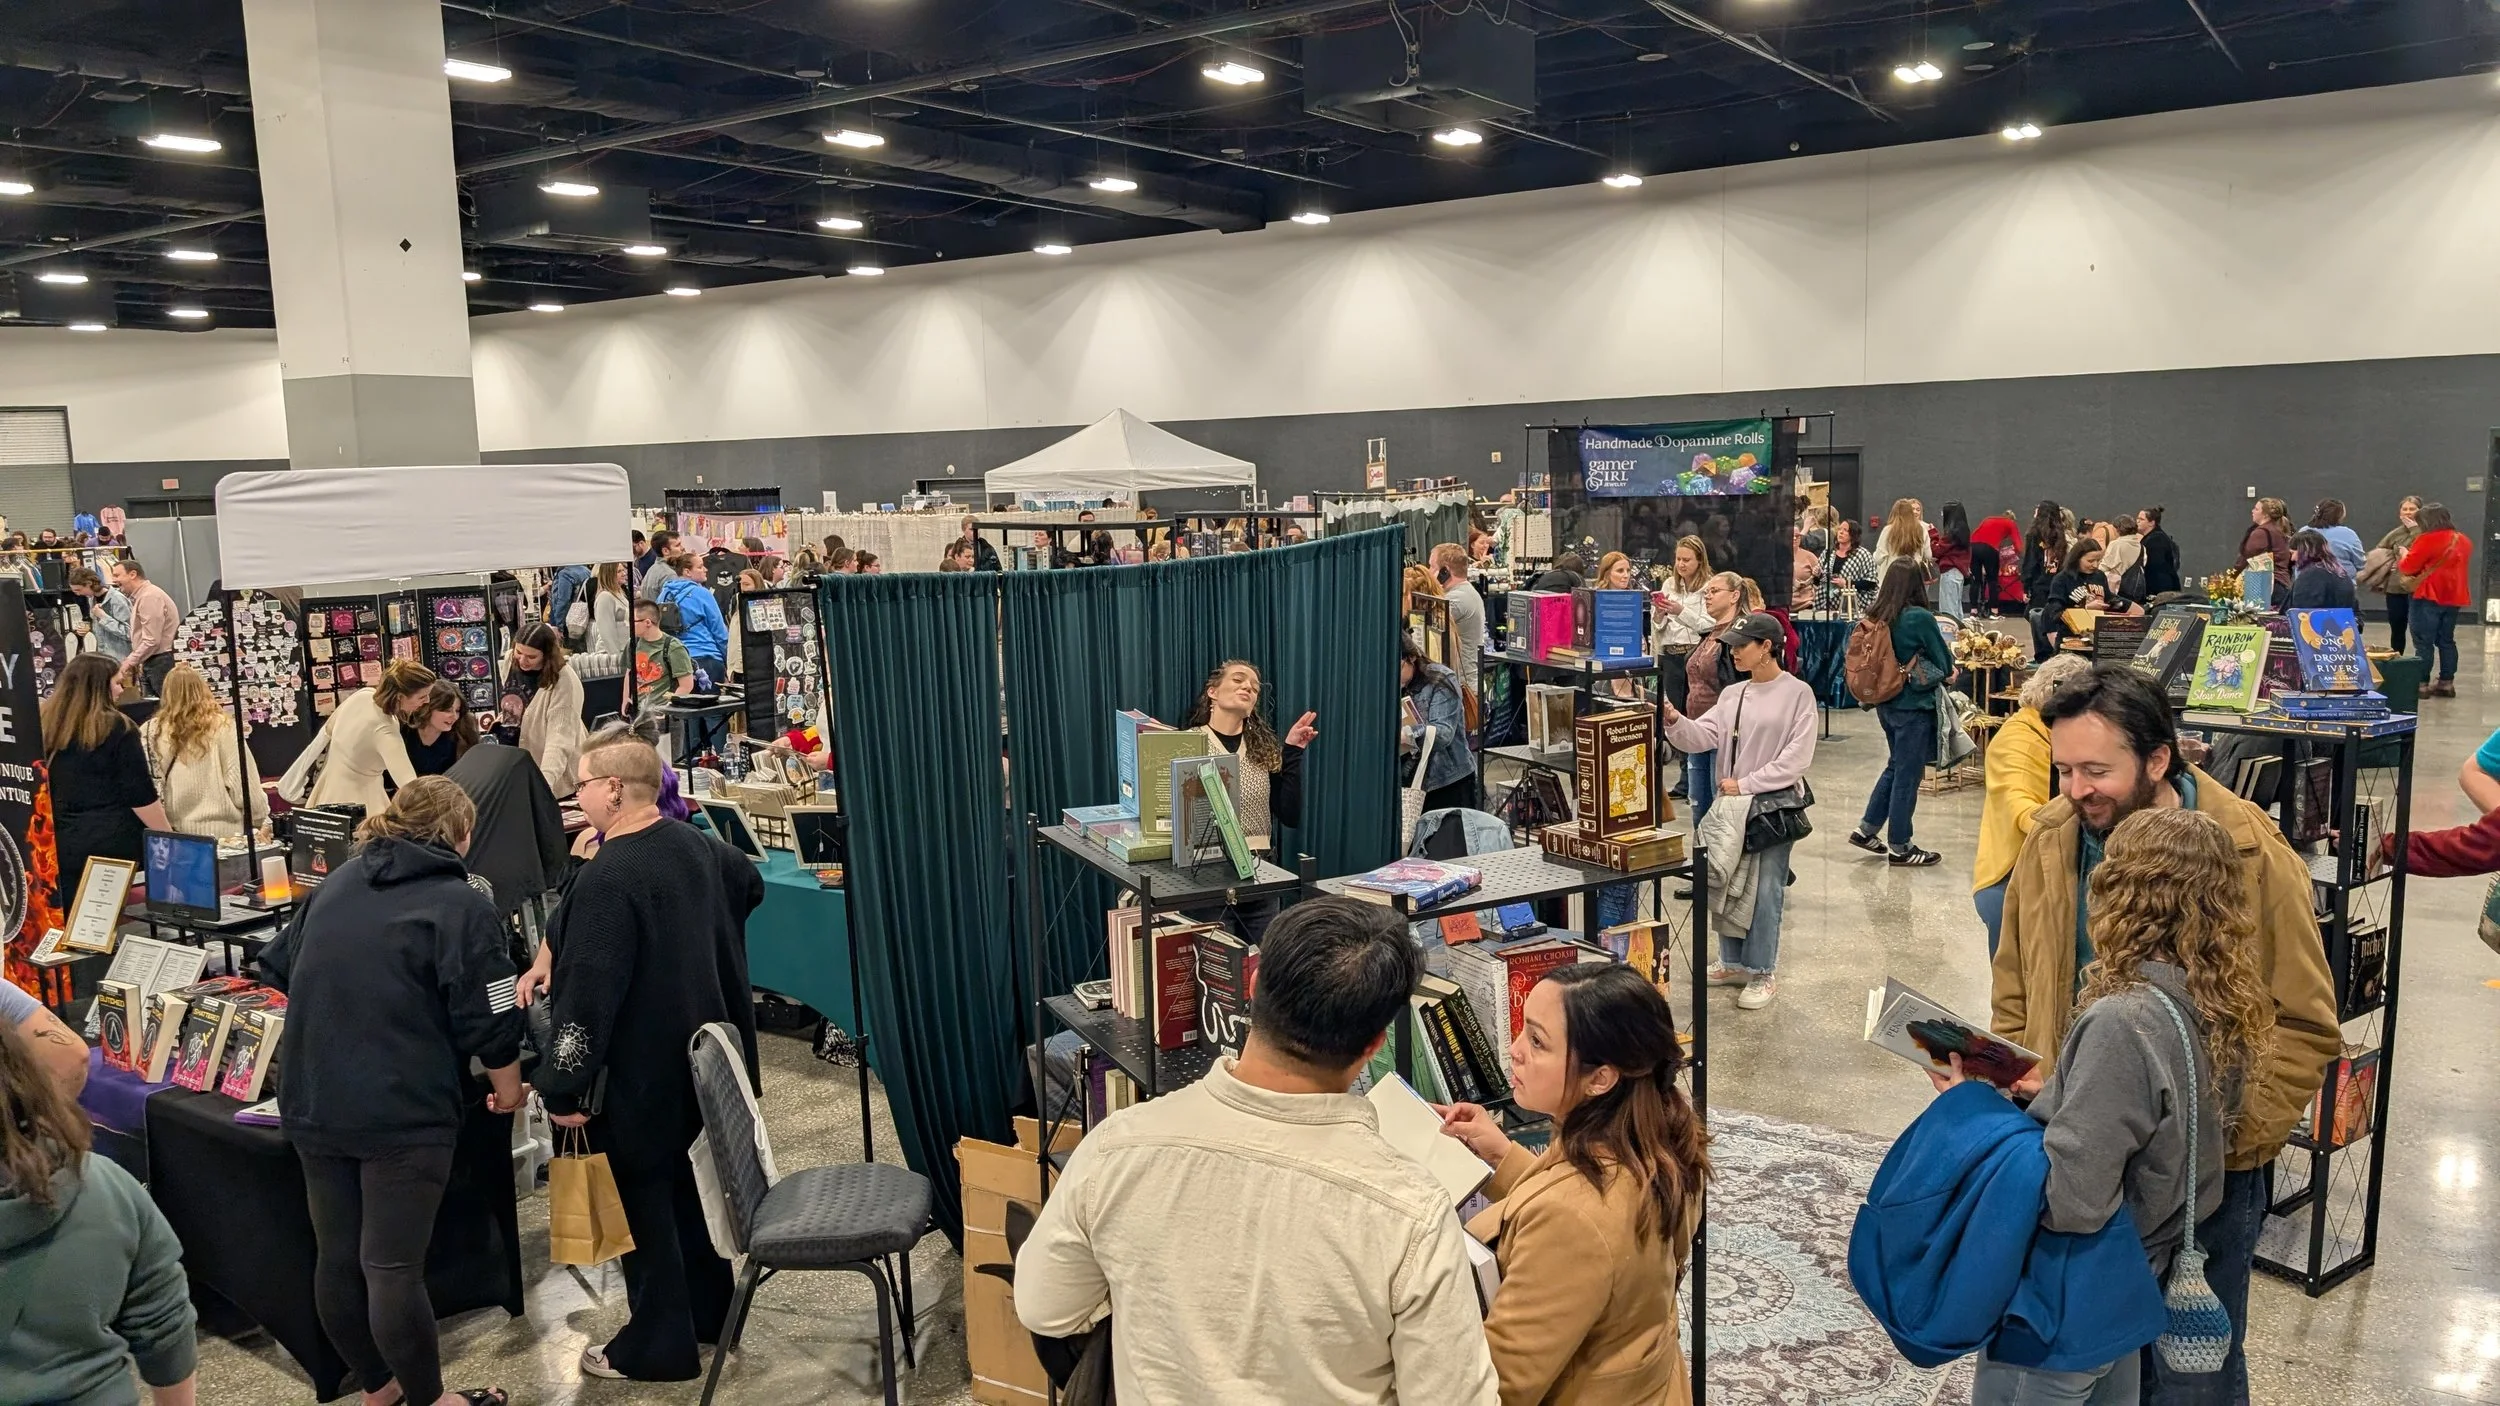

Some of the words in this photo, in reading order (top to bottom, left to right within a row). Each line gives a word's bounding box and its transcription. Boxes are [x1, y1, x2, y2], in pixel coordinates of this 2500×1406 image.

[1586, 438, 1652, 450] Handmade
[1655, 434, 1731, 452] Dopamine
[1734, 432, 1764, 444] Rolls
[1589, 460, 1637, 472] gamer
[2159, 618, 2181, 629] LEIGH
[2146, 628, 2182, 642] BARO
[2205, 632, 2256, 647] RAINBOW
[2315, 637, 2345, 648] SONG
[2211, 644, 2248, 658] ROWELL
[2314, 654, 2356, 663] DROWN
[2317, 665, 2359, 675] RIVERS
[2192, 689, 2215, 700] Slow
[2217, 689, 2244, 700] Dance
[1606, 725, 1628, 737] Robert
[1630, 722, 1648, 732] Louis
[1610, 732, 1643, 743] Stevenson
[0, 763, 34, 782] NIQUE
[1509, 954, 1542, 965] ROSHANI
[1544, 949, 1577, 960] CHOKSHI
[1436, 1005, 1445, 1019] THE
[1440, 1019, 1460, 1053] LUMINOUS
[1464, 1006, 1477, 1031] GILDED
[1475, 1030, 1489, 1055] WOLVES
